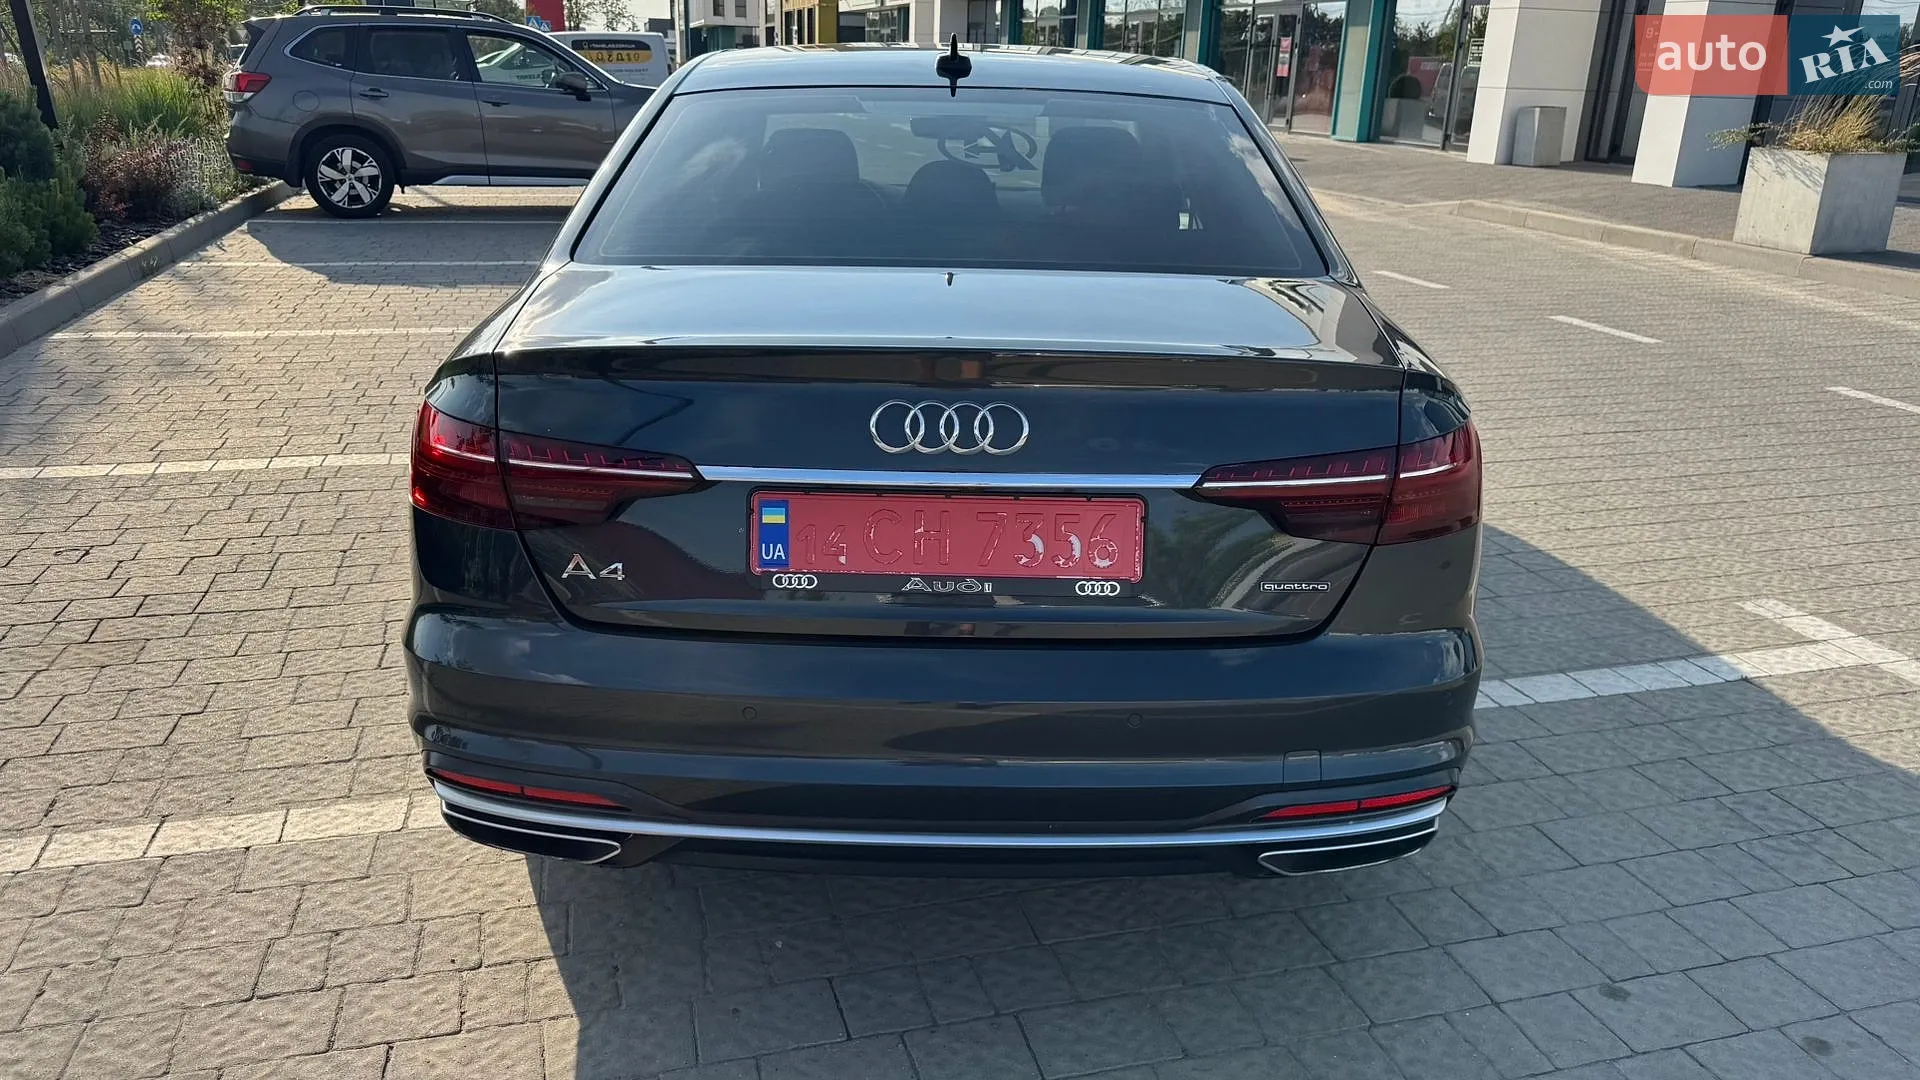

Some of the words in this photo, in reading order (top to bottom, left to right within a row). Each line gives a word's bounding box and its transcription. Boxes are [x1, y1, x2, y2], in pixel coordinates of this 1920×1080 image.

[796, 524, 849, 565] 14
[863, 508, 950, 566] CH
[976, 511, 1119, 569] 7356
[761, 543, 786, 560] UA
[561, 553, 626, 581] A4
[1264, 583, 1328, 591] quattro
